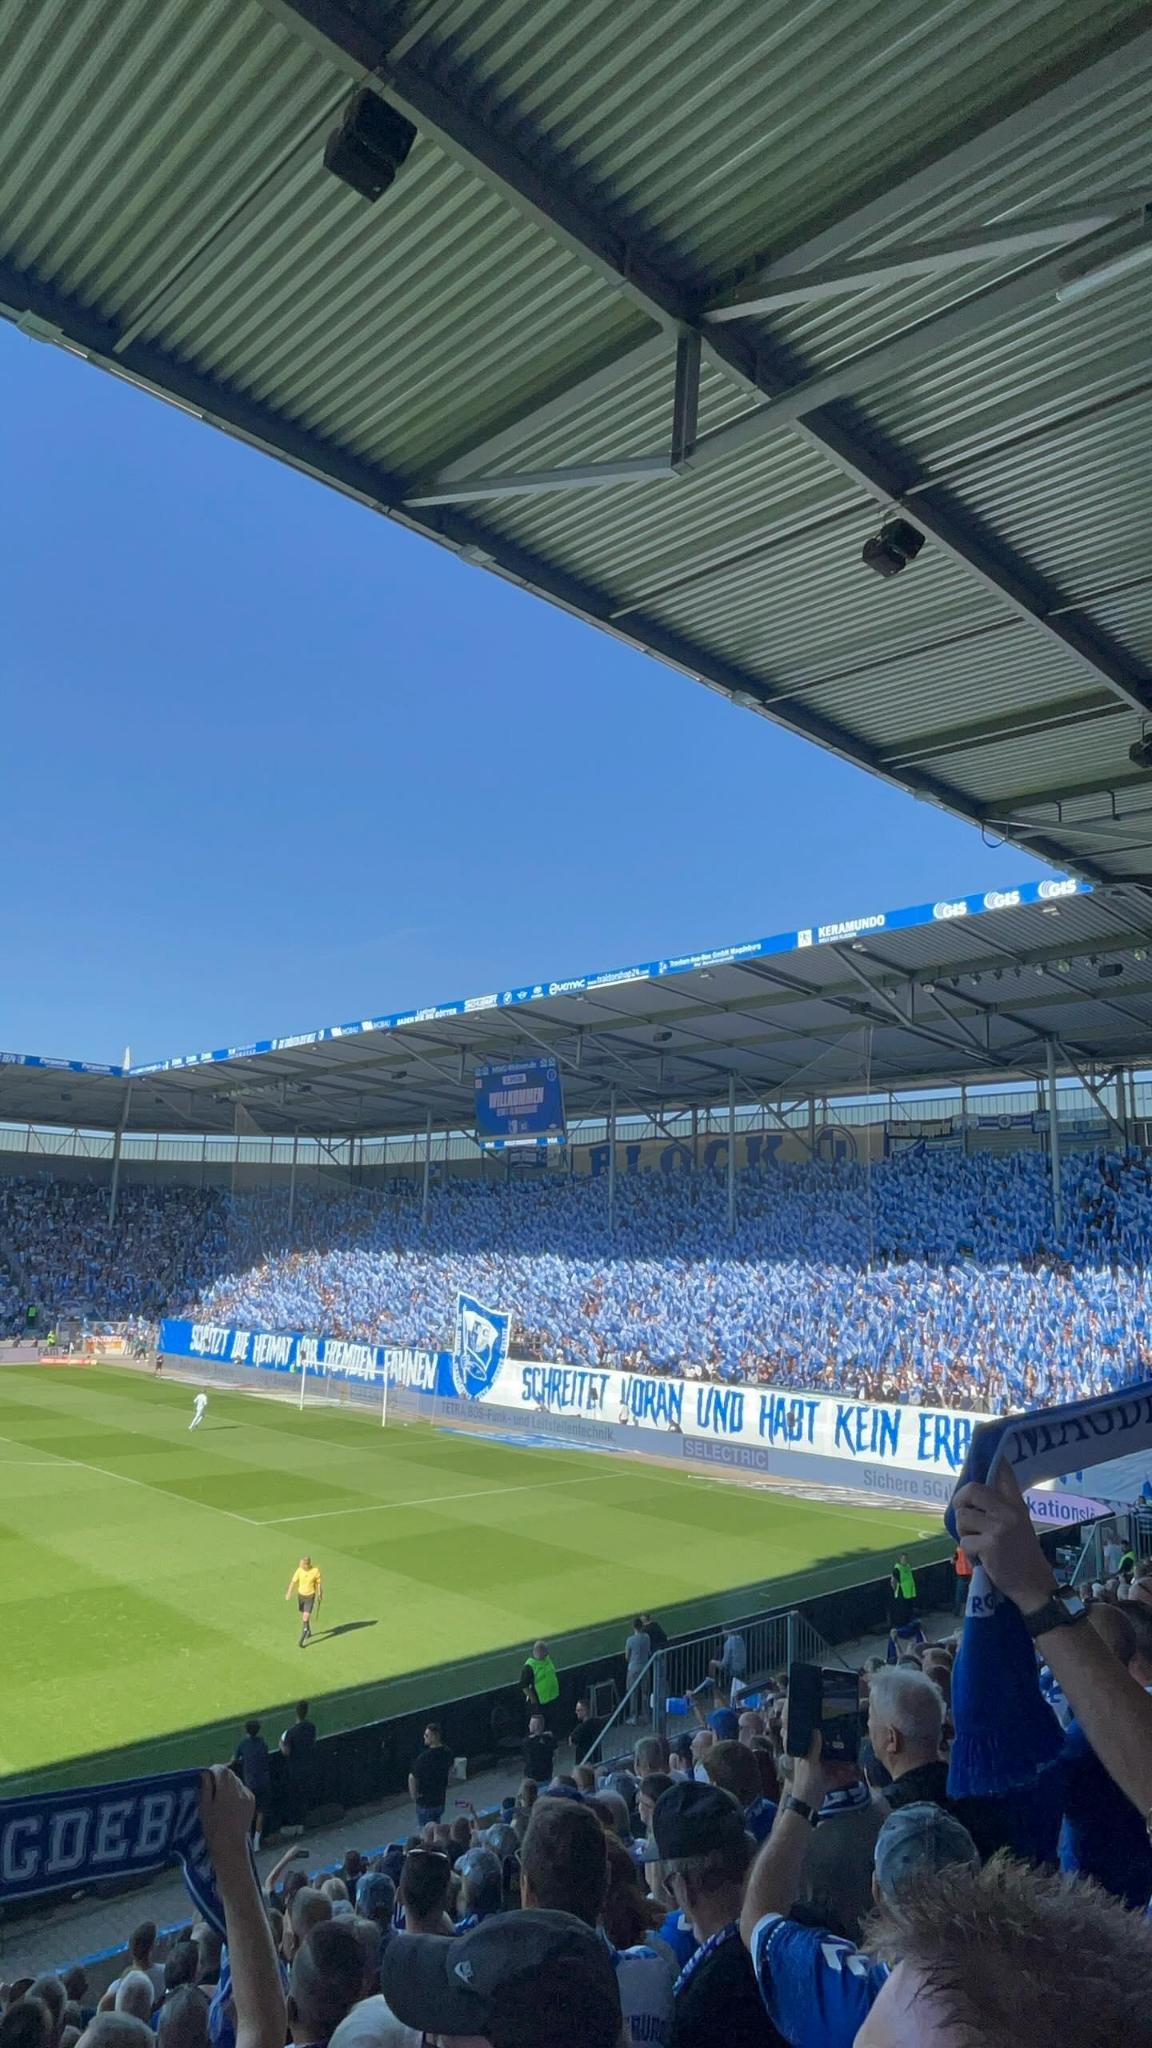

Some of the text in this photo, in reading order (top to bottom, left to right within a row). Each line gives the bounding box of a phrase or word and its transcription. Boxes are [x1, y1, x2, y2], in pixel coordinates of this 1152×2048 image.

[817, 914, 885, 938] KERAMUNDO
[231, 1331, 251, 1360] DIE
[252, 1334, 294, 1367] HEIMAT
[296, 1336, 319, 1374] VOR
[323, 1340, 378, 1380] FREMDEN
[383, 1347, 438, 1390] FAHNEN
[522, 1367, 972, 1472] SCHREITET VORAN UND HABT KEIN ERB
[684, 1441, 767, 1467] SELECTRIC
[863, 1469, 919, 1494] Sichere
[922, 1481, 942, 1497] 5G
